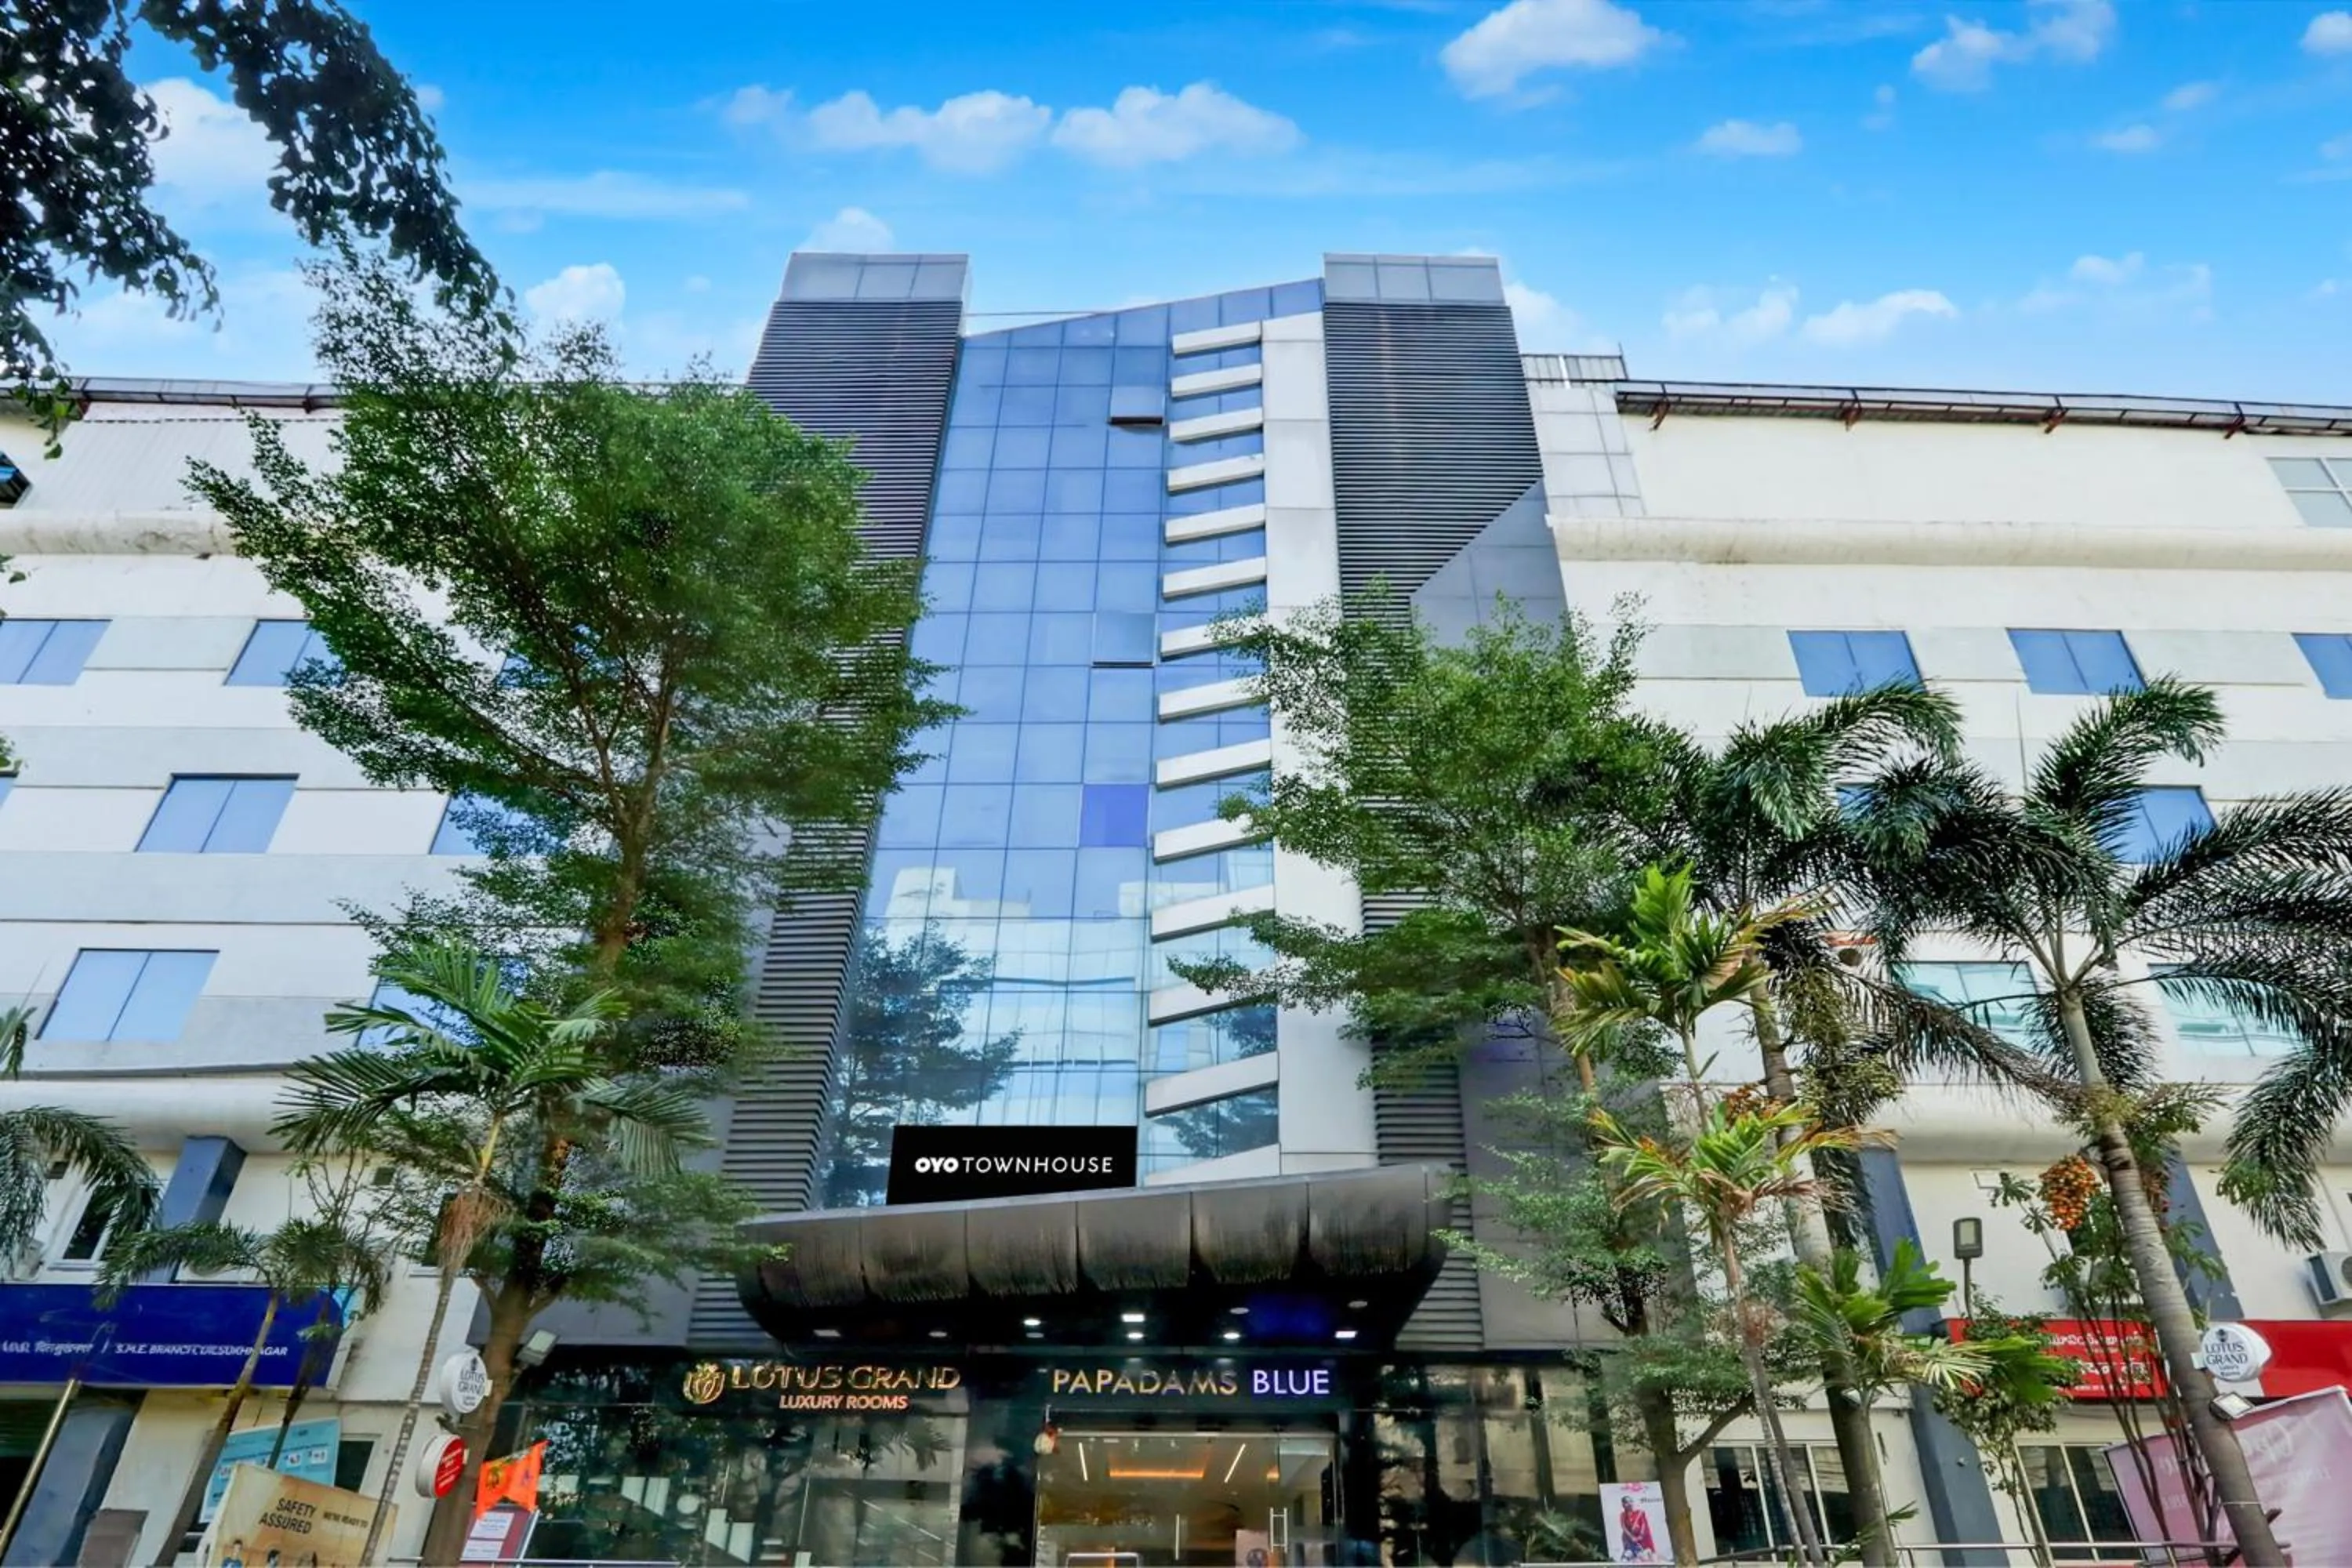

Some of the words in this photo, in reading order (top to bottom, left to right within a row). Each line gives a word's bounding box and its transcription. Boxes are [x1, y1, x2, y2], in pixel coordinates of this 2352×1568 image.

[915, 1156, 959, 1174] OYO
[962, 1156, 1113, 1174] TOWNHOUSE
[2205, 1341, 2245, 1354] LOTUS
[2205, 1352, 2248, 1365] GRAND
[460, 1368, 485, 1382] LOTUS
[731, 1364, 843, 1390] LOTUS
[848, 1365, 961, 1390] GRAND
[1052, 1370, 1239, 1395] PAPADAMS
[1253, 1370, 1330, 1395] BLUE
[779, 1394, 843, 1410] LUXURY
[845, 1394, 909, 1410] ROOMS
[276, 1497, 318, 1518] SAFETY
[258, 1512, 313, 1534] ASSURED
